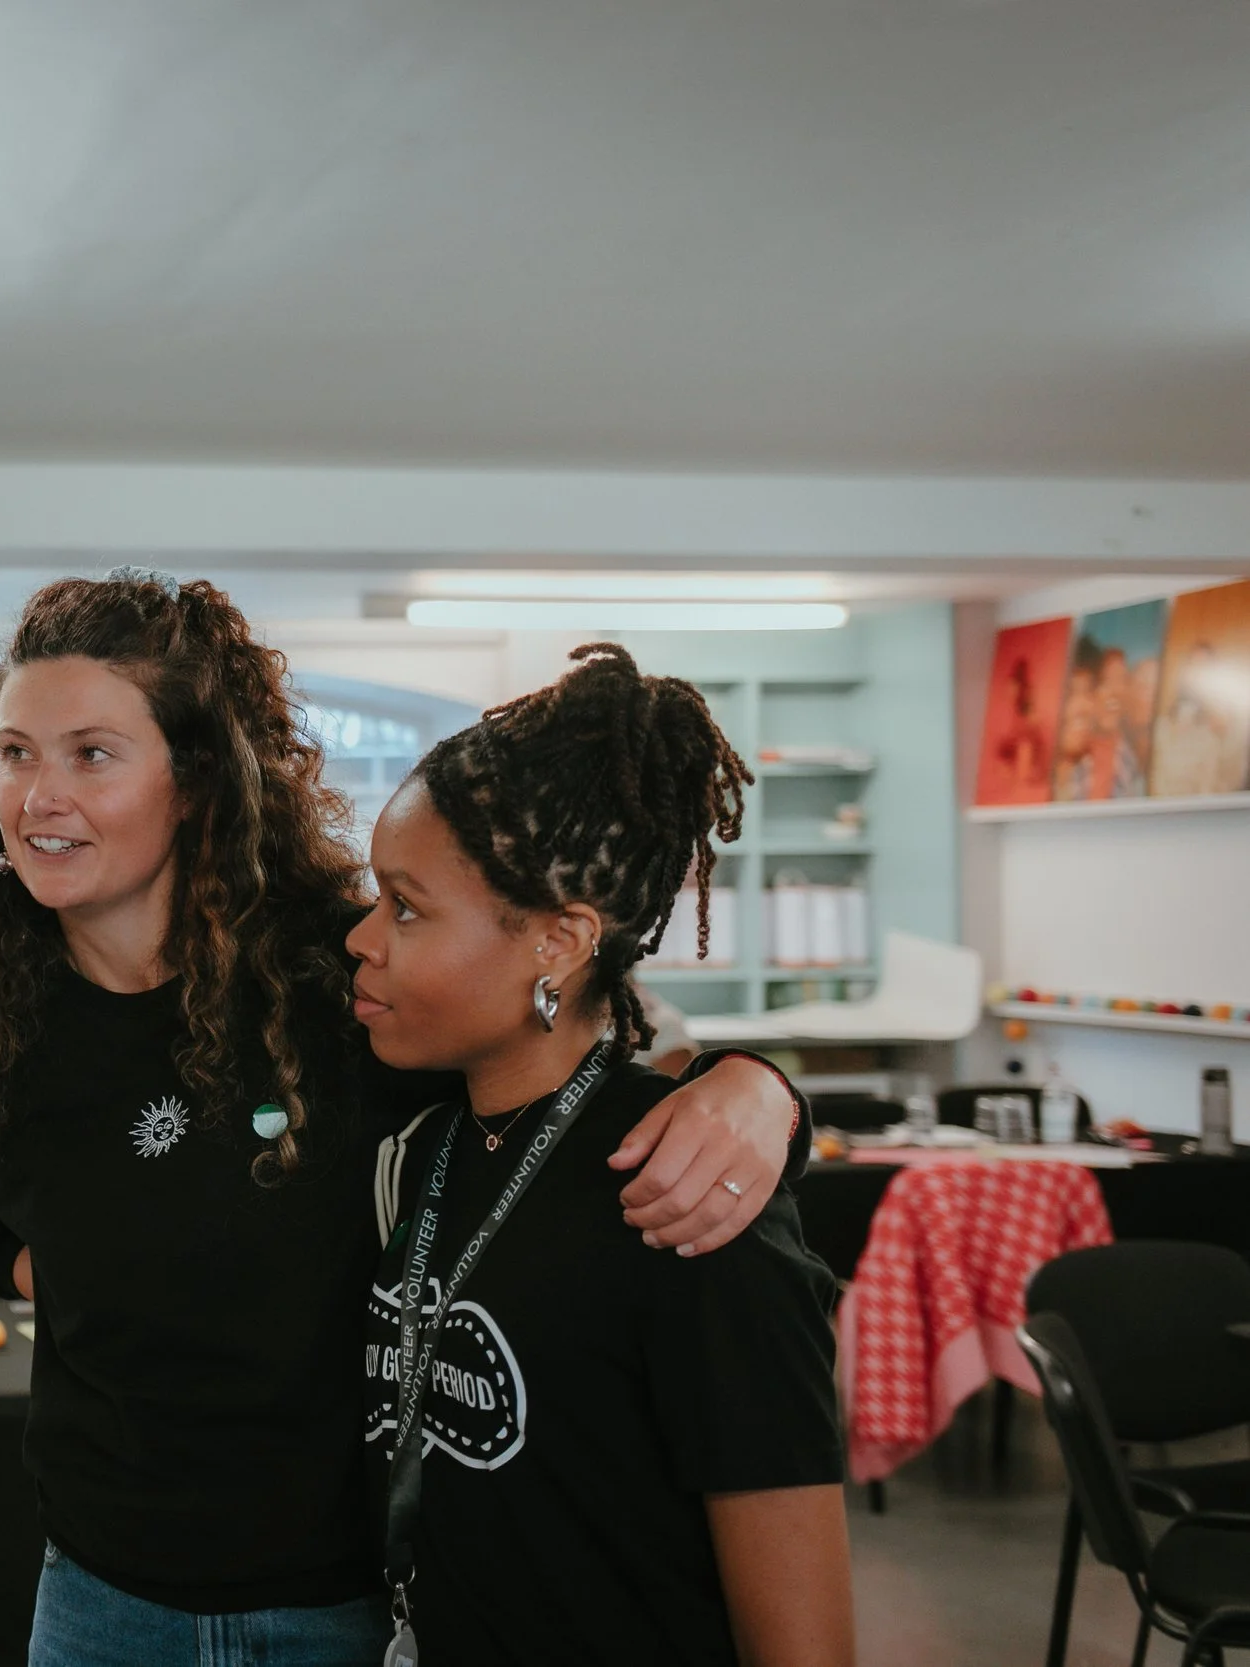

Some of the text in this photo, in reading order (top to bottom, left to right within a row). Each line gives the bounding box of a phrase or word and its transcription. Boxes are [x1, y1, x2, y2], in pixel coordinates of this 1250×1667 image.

[405, 1208, 439, 1310] VOLUNTEER
[429, 1105, 466, 1198] VOLUNTEER
[492, 1125, 558, 1221] VOLUNTEER
[431, 1231, 489, 1330] VOLUNTEER
[397, 1343, 433, 1447] VOLUNTEER
[431, 1360, 496, 1410] PERIOD
